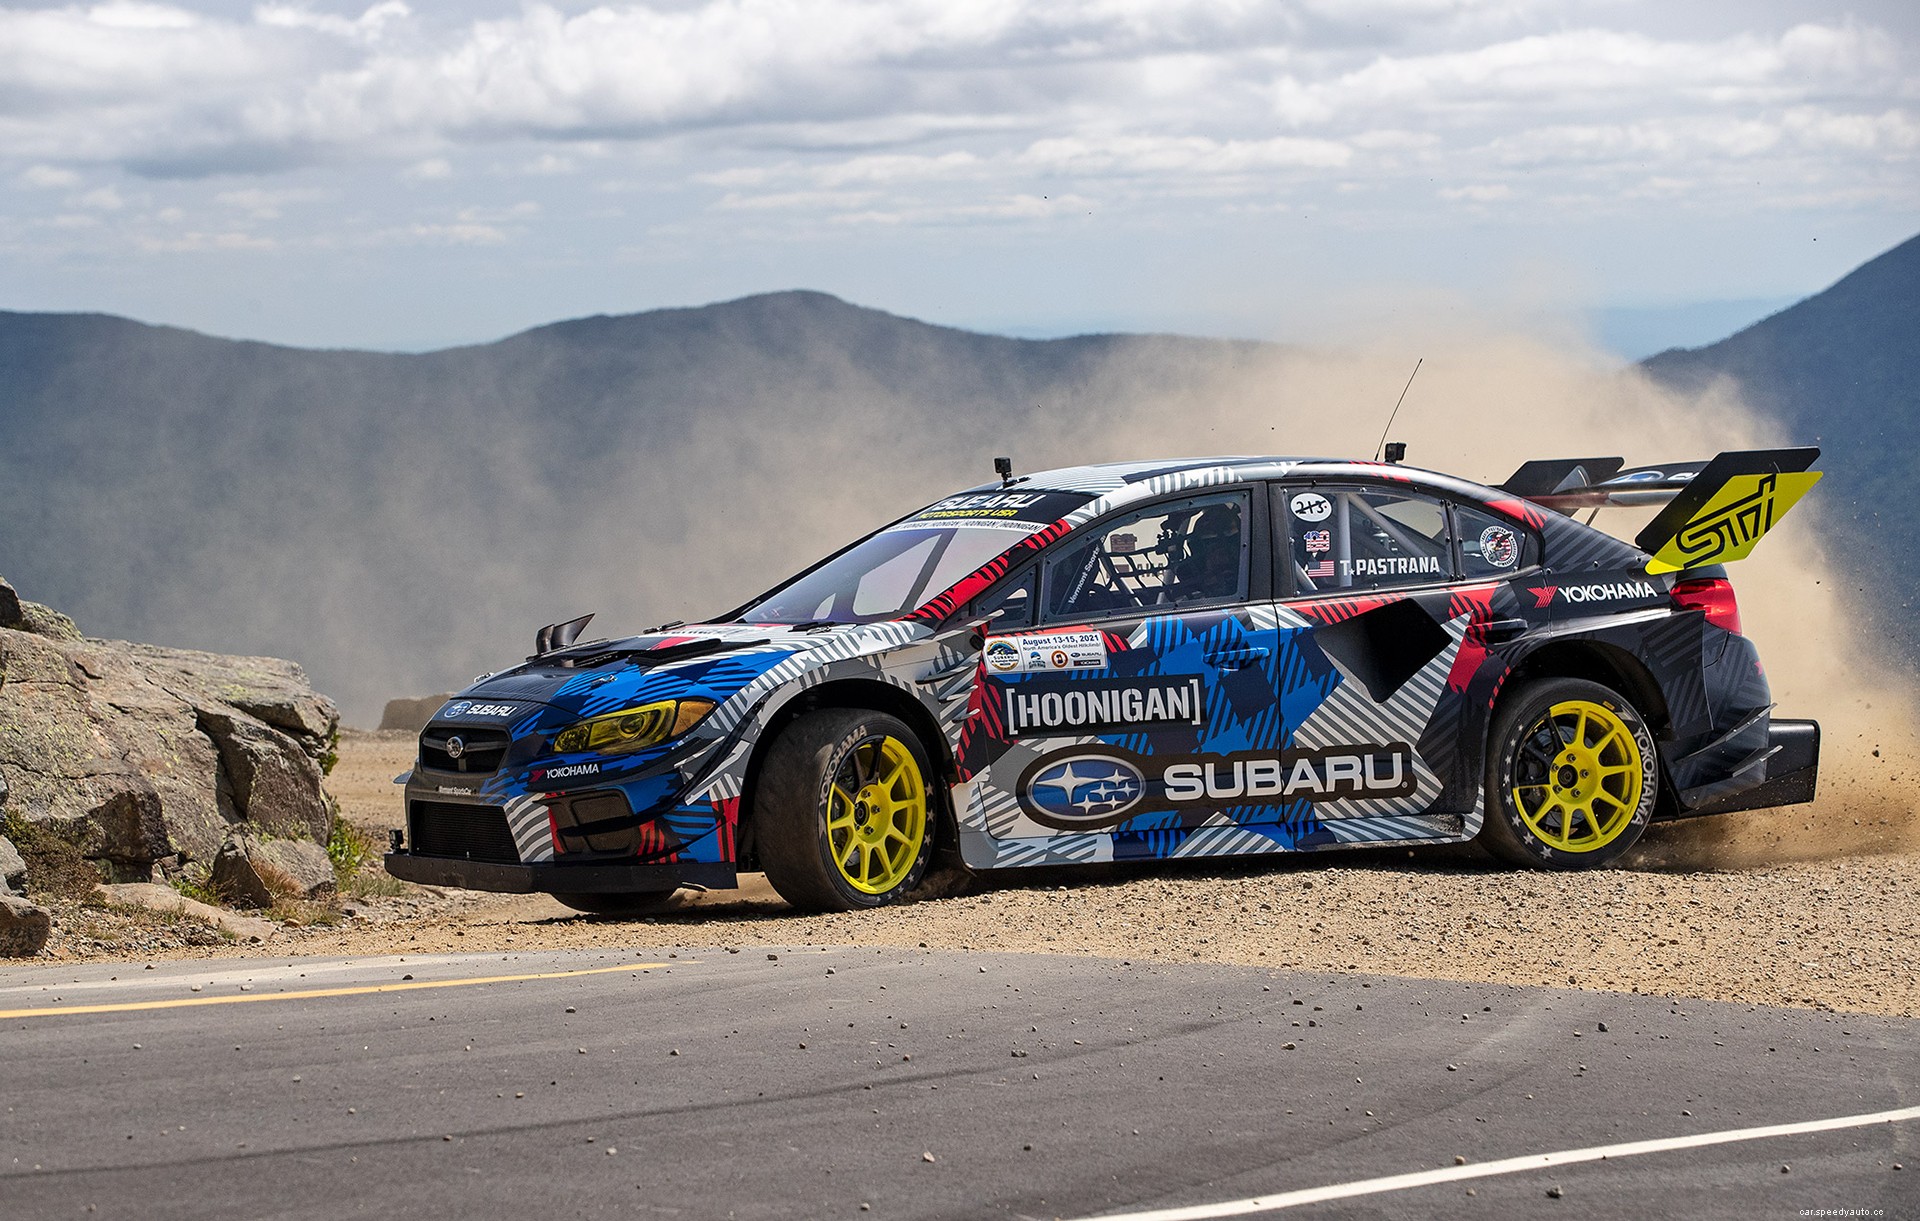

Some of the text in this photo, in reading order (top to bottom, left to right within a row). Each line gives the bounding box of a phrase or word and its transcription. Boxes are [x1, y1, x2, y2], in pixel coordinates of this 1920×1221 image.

[989, 509, 1019, 517] USA
[1068, 571, 1089, 604] Vermont
[1558, 581, 1659, 604] YOKOHAMA
[1022, 637, 1051, 646] August
[1053, 635, 1078, 644] 13-15,
[1079, 634, 1099, 642] 2021
[466, 704, 518, 717] SUBARU
[546, 763, 600, 779] YOKOHAMA
[818, 725, 868, 806] YOKOHAMA
[1163, 752, 1404, 801] SUBARU
[1630, 727, 1656, 826] YOKOHAMA
